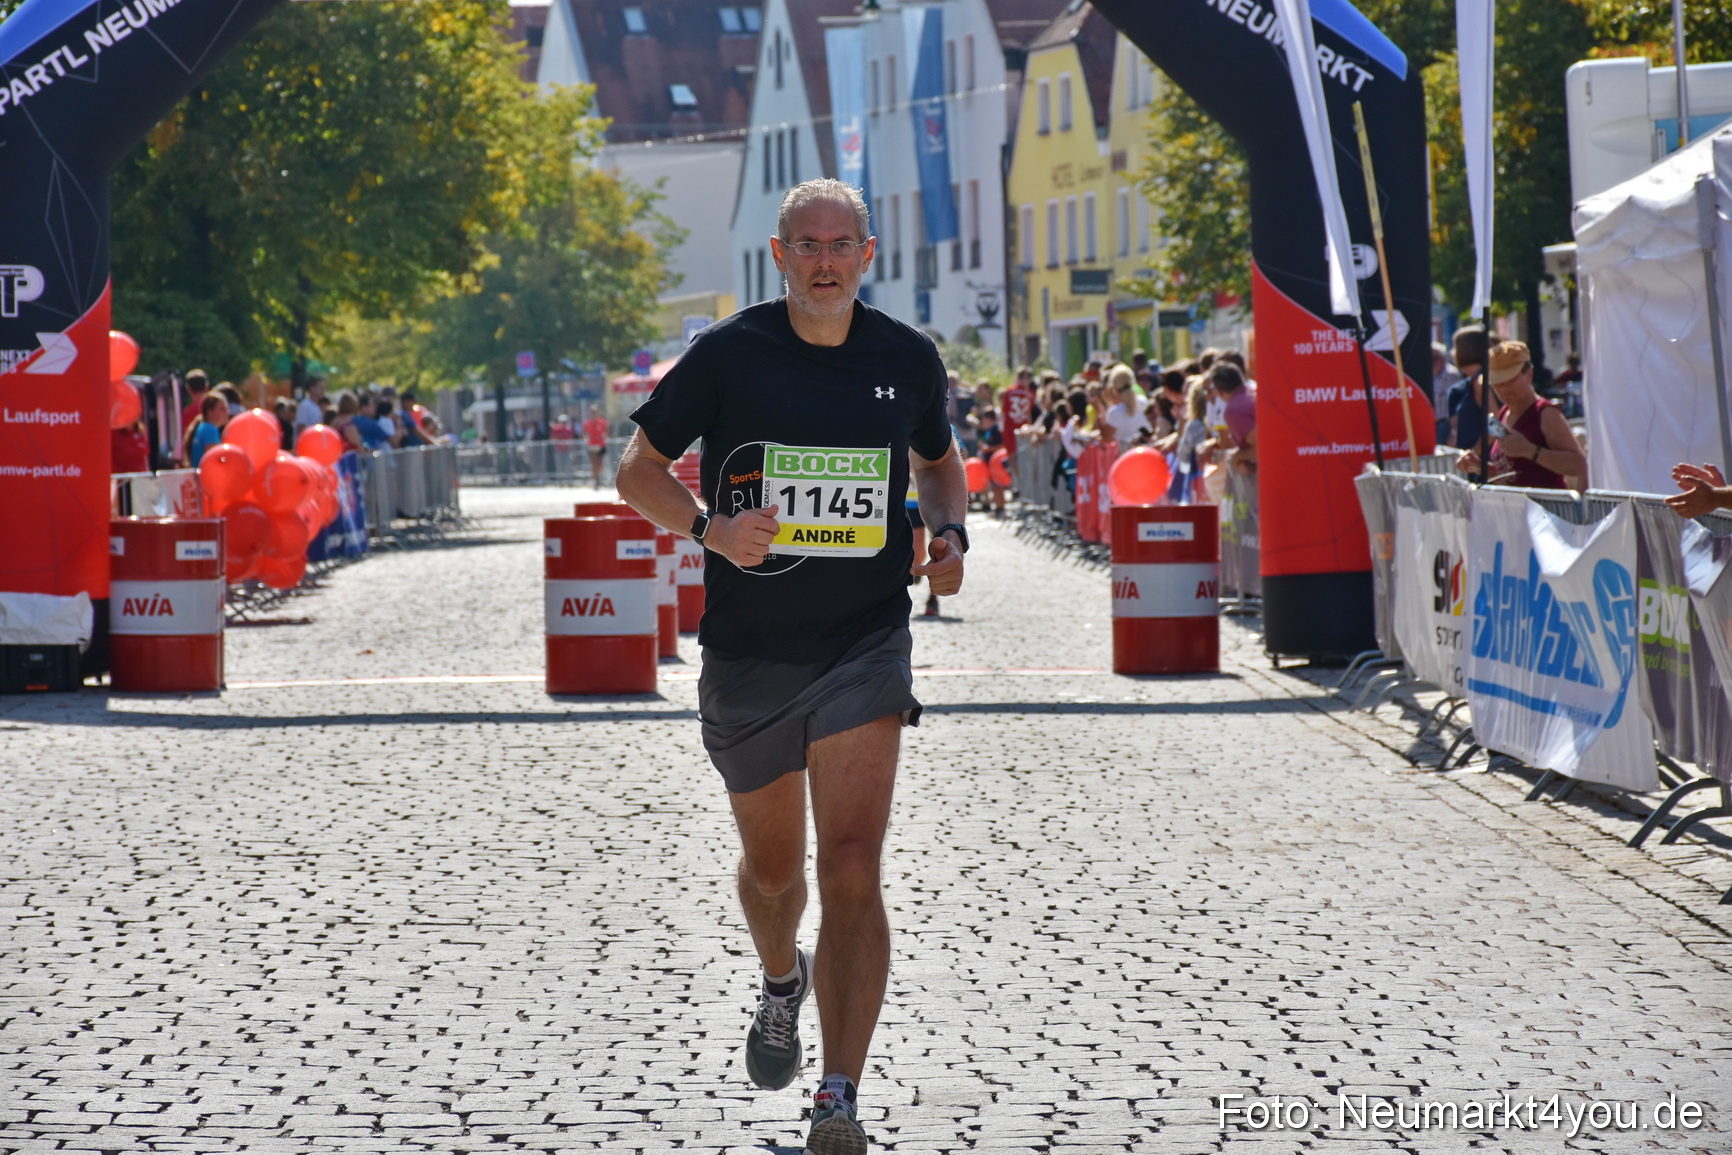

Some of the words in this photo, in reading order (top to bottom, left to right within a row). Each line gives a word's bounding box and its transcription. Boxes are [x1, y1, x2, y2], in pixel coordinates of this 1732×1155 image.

[0, 44, 89, 115] PARTL
[1312, 330, 1334, 341] THE
[1294, 343, 1313, 354] 100
[1315, 341, 1354, 353] YEARS
[1294, 387, 1338, 403] BMW
[3, 409, 81, 426] Laufsport
[775, 452, 880, 477] BOCK
[779, 486, 873, 519] 1145
[792, 527, 856, 544] ANDRÉ
